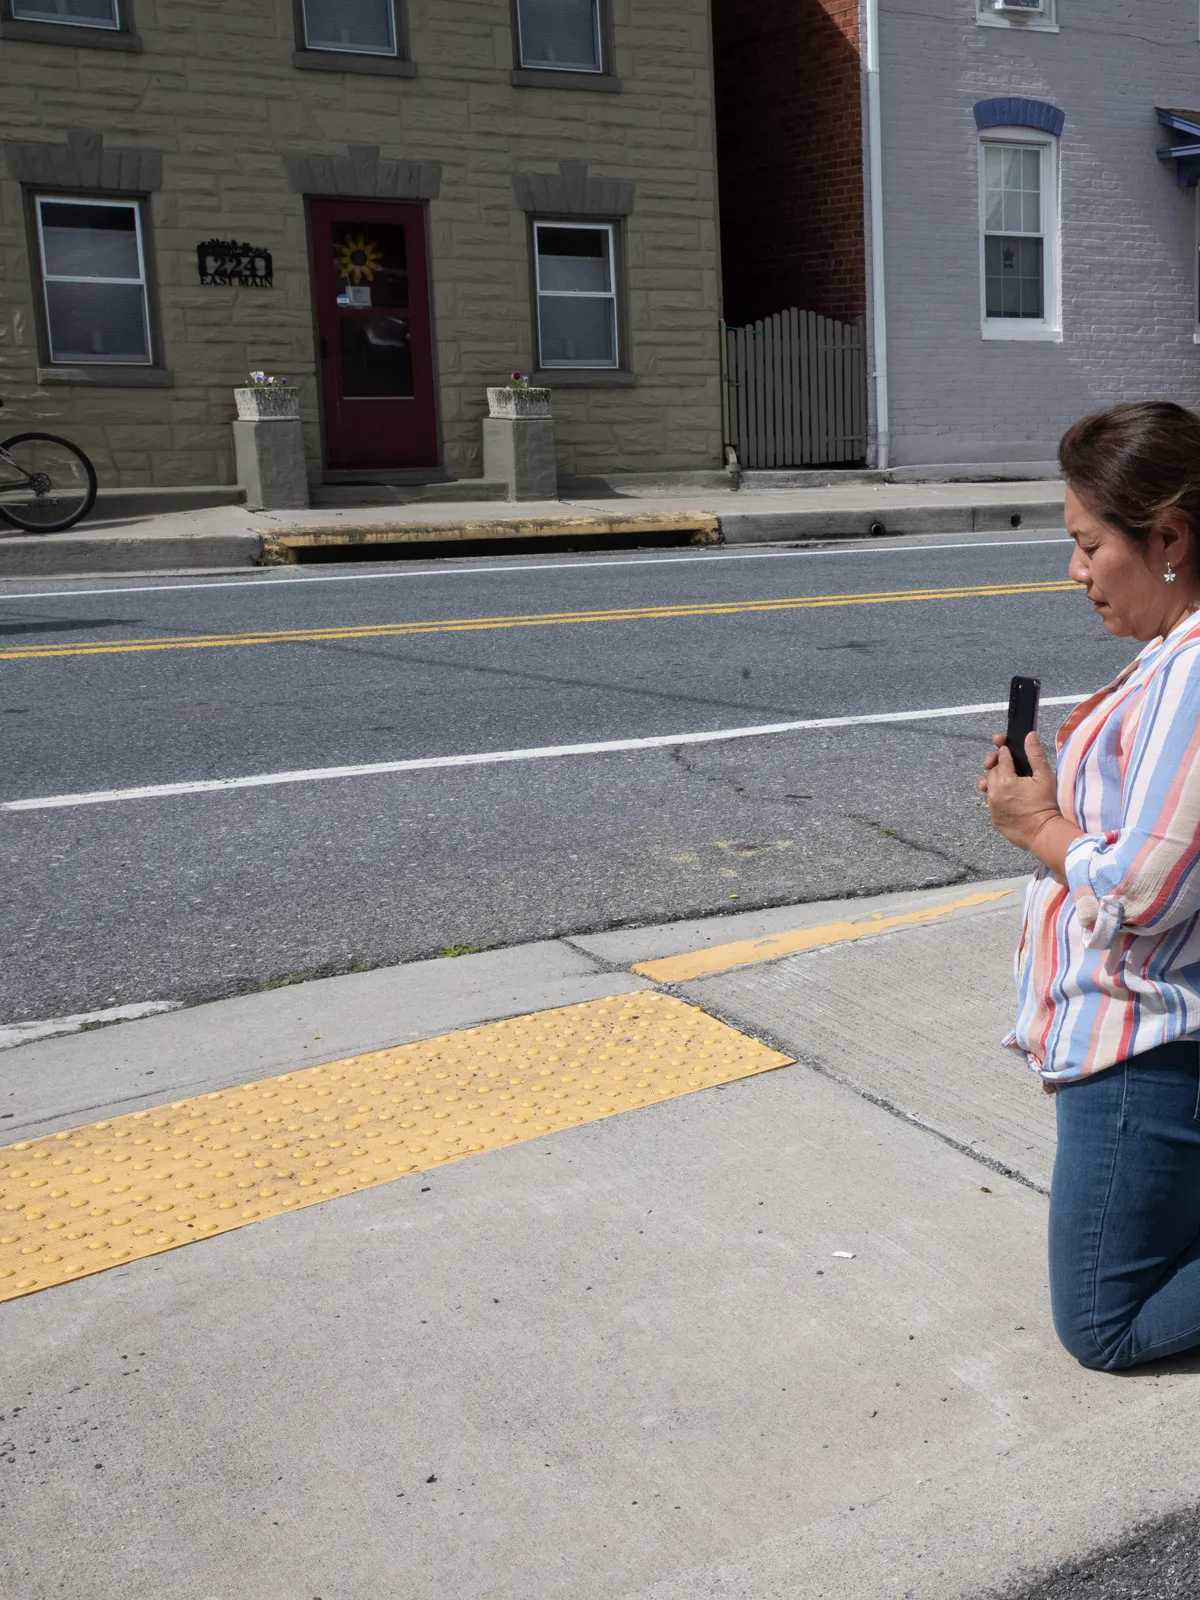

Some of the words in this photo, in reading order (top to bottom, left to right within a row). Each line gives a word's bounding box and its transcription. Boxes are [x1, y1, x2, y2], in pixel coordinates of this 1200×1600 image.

[212, 254, 257, 276] 224
[200, 275, 232, 287] EAST
[239, 276, 273, 288] MAIN
